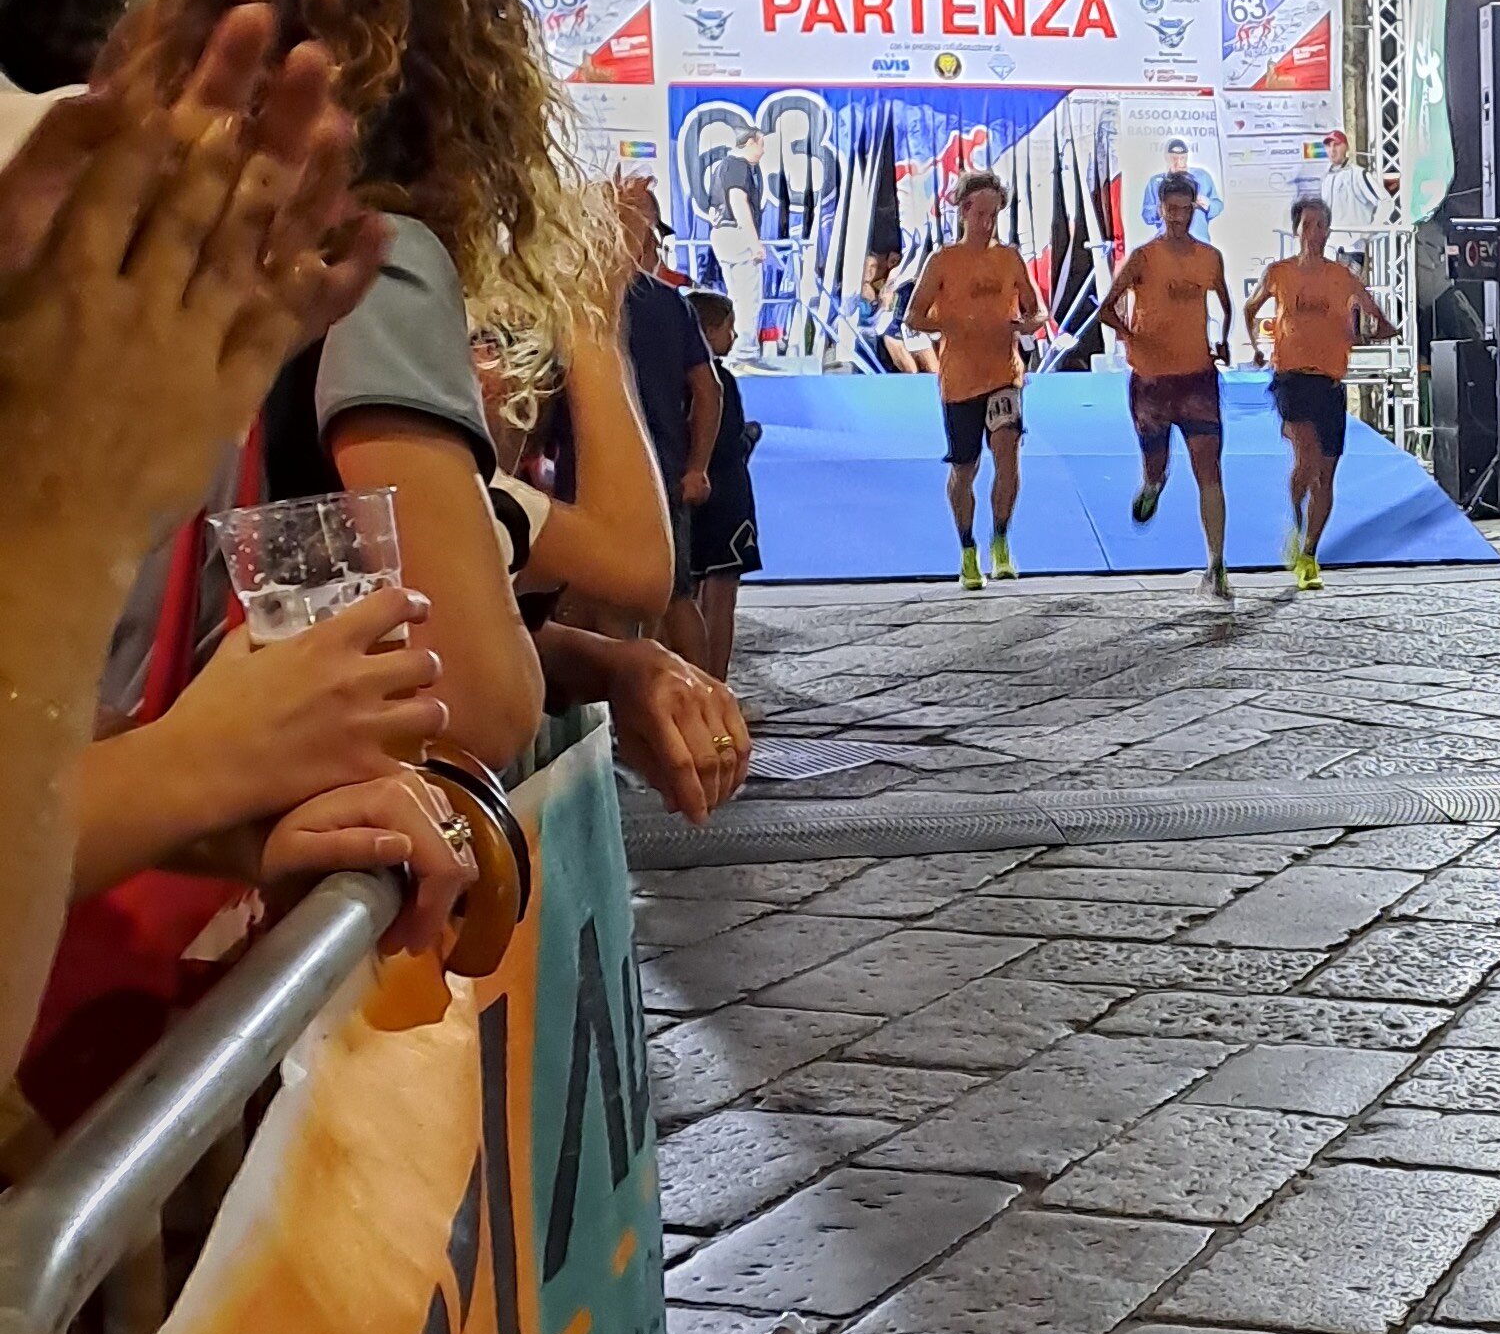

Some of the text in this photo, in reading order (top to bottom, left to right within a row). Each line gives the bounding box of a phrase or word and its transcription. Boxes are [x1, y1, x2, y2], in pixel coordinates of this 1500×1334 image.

[872, 59, 910, 71] AVIS
[1128, 109, 1217, 121] ASSOCIAZIONE
[682, 93, 842, 215] 63
